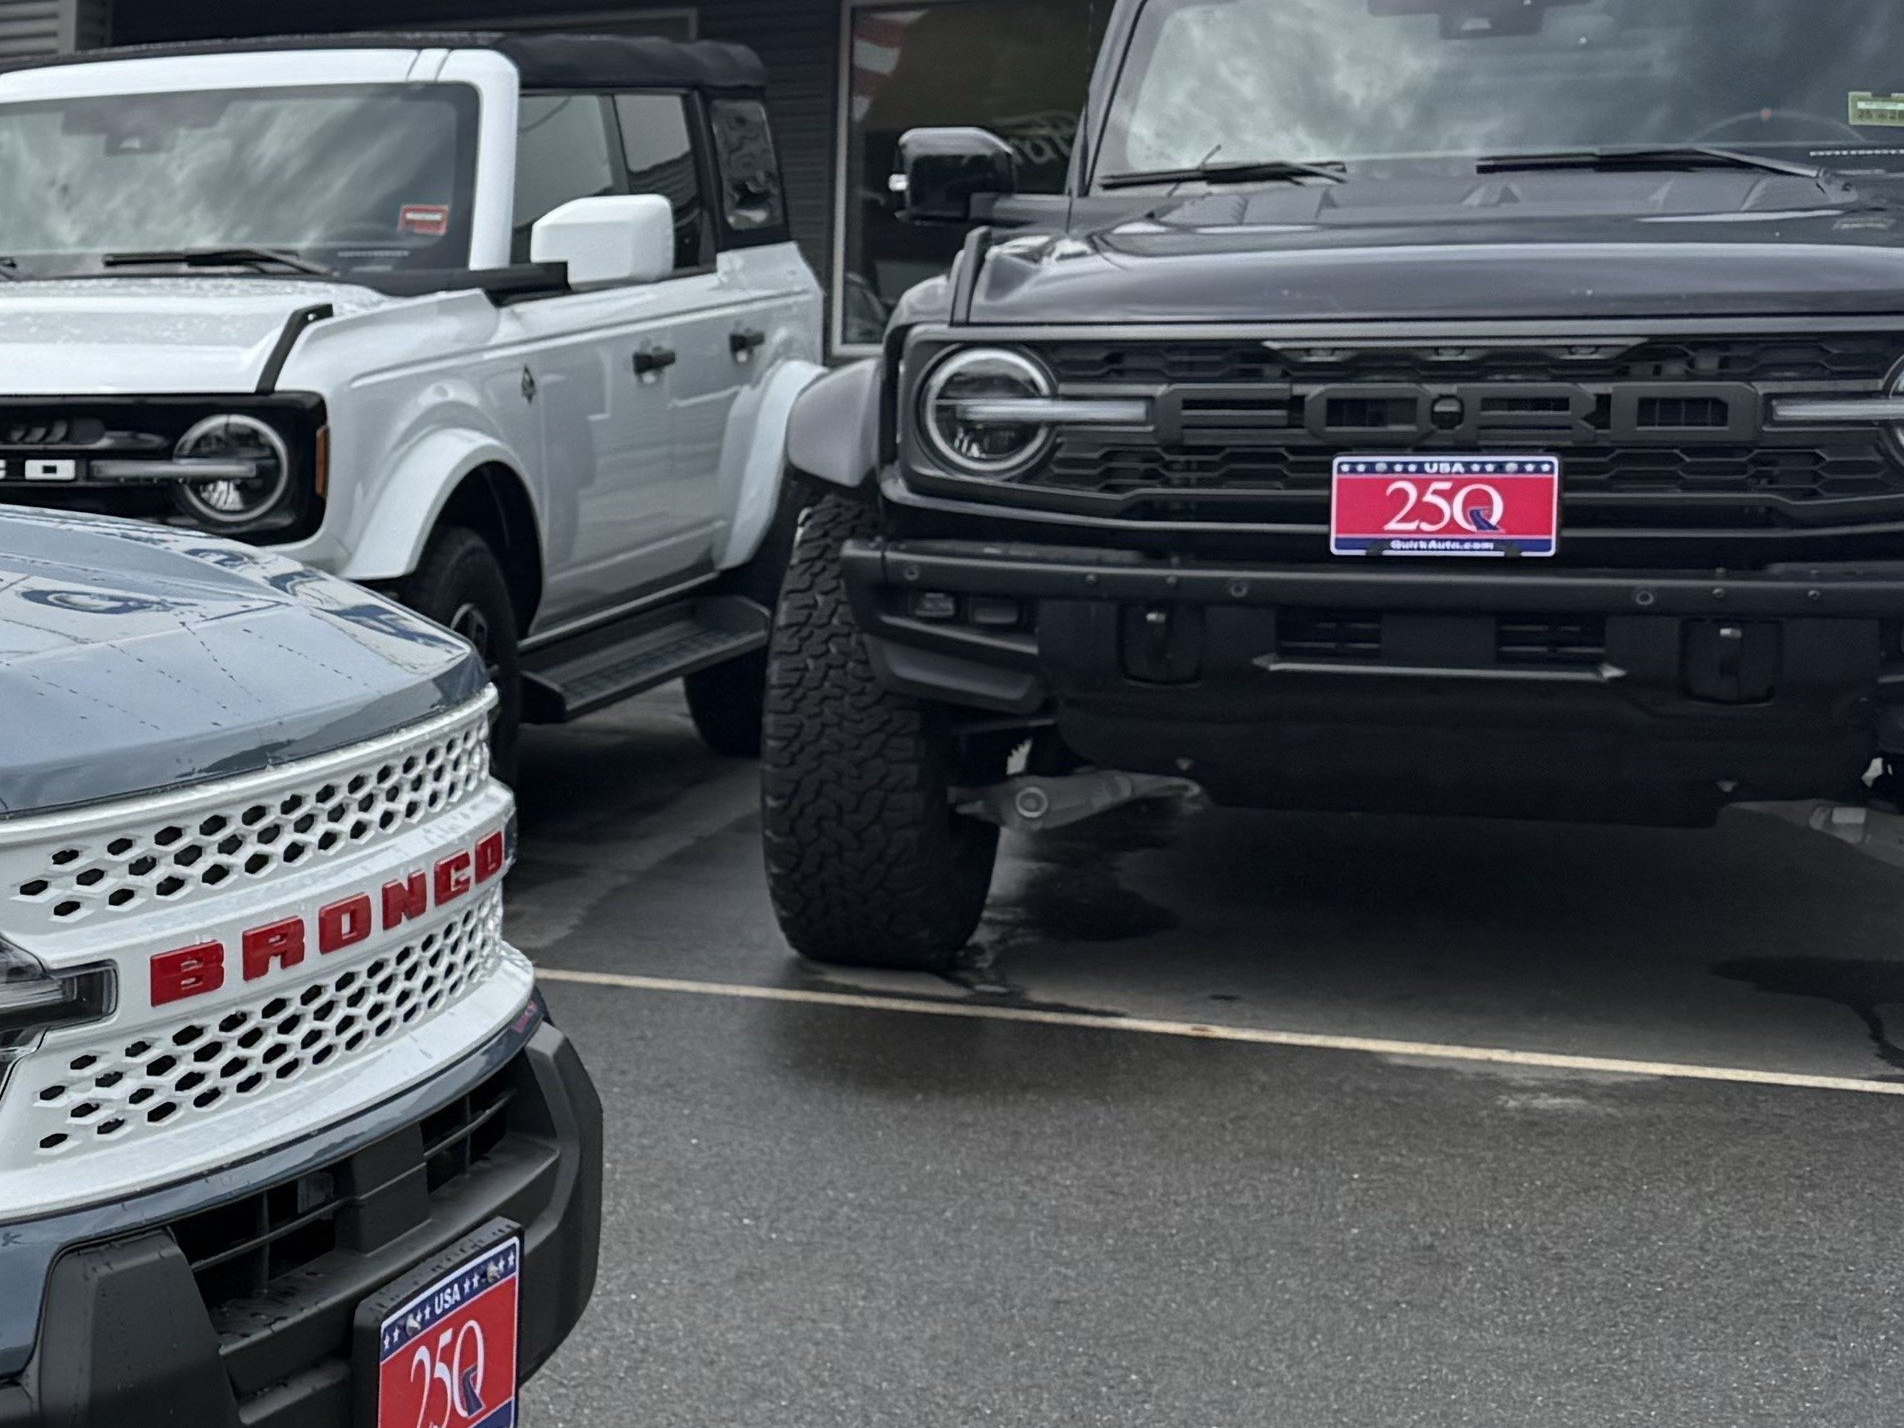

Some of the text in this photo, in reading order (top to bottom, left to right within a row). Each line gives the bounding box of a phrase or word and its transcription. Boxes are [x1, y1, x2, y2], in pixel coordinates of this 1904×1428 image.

[1156, 380, 1764, 445] FORD
[1423, 462, 1466, 474] USA
[1389, 538, 1495, 552] QuirkAuto.com
[149, 830, 505, 1007] BRONCO
[433, 1284, 462, 1315] USA
